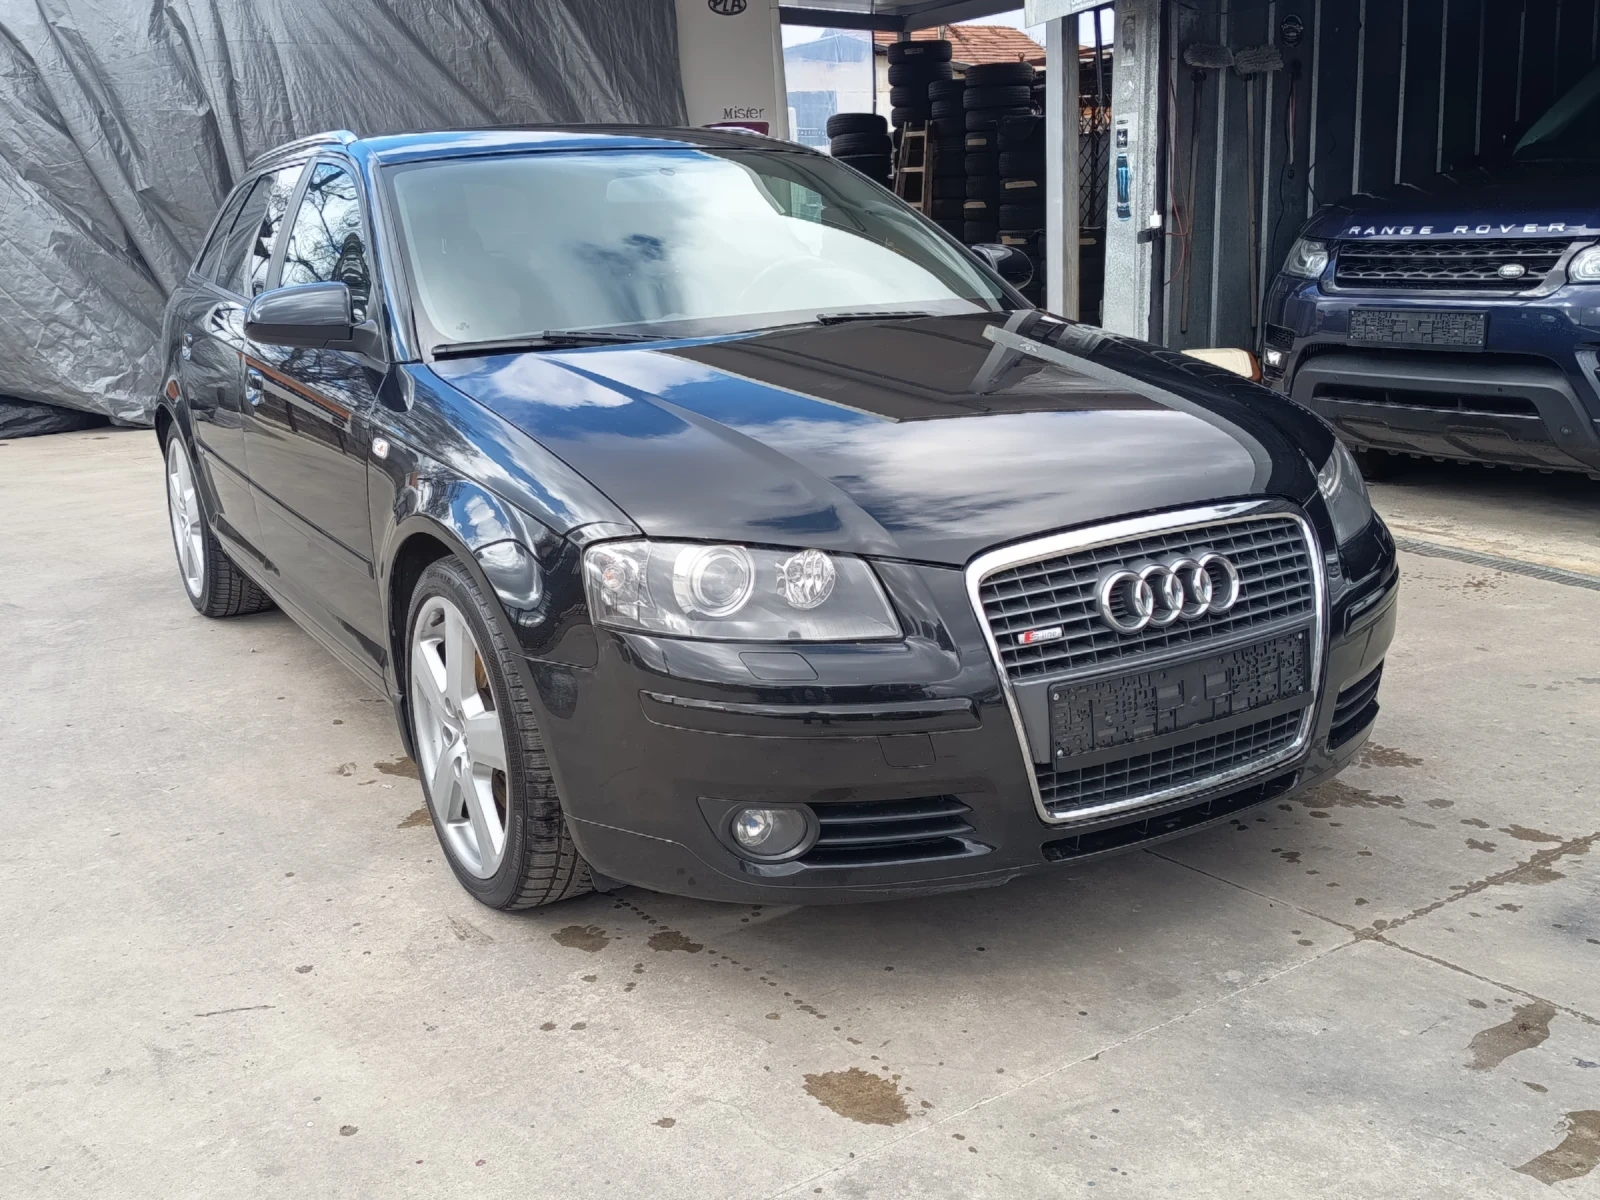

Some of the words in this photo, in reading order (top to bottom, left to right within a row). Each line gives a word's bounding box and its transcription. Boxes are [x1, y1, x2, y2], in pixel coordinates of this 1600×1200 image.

[722, 106, 765, 120] Mister
[1348, 225, 1434, 236] RANGE
[1452, 222, 1566, 235] ROVER
